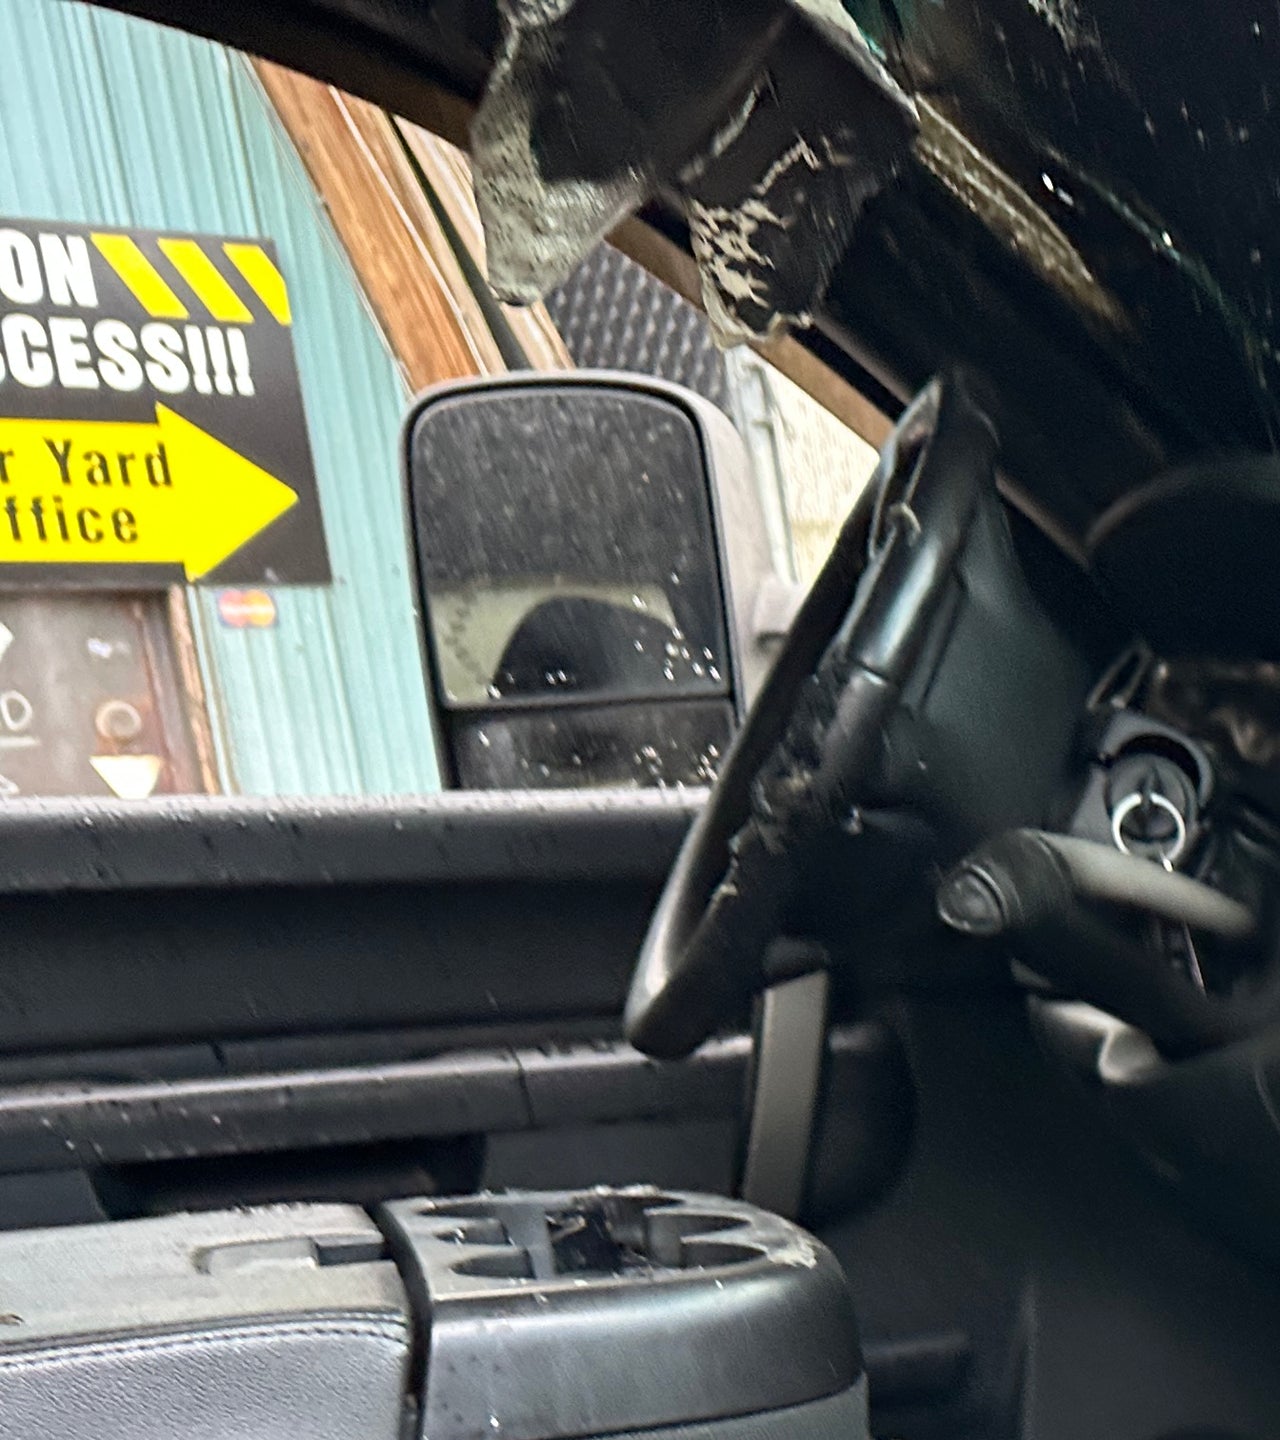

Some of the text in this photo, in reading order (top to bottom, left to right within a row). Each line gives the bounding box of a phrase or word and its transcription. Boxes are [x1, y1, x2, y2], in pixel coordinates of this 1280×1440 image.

[0, 228, 99, 309] ON
[0, 313, 256, 397] CESS!!!
[43, 437, 174, 488] Yard
